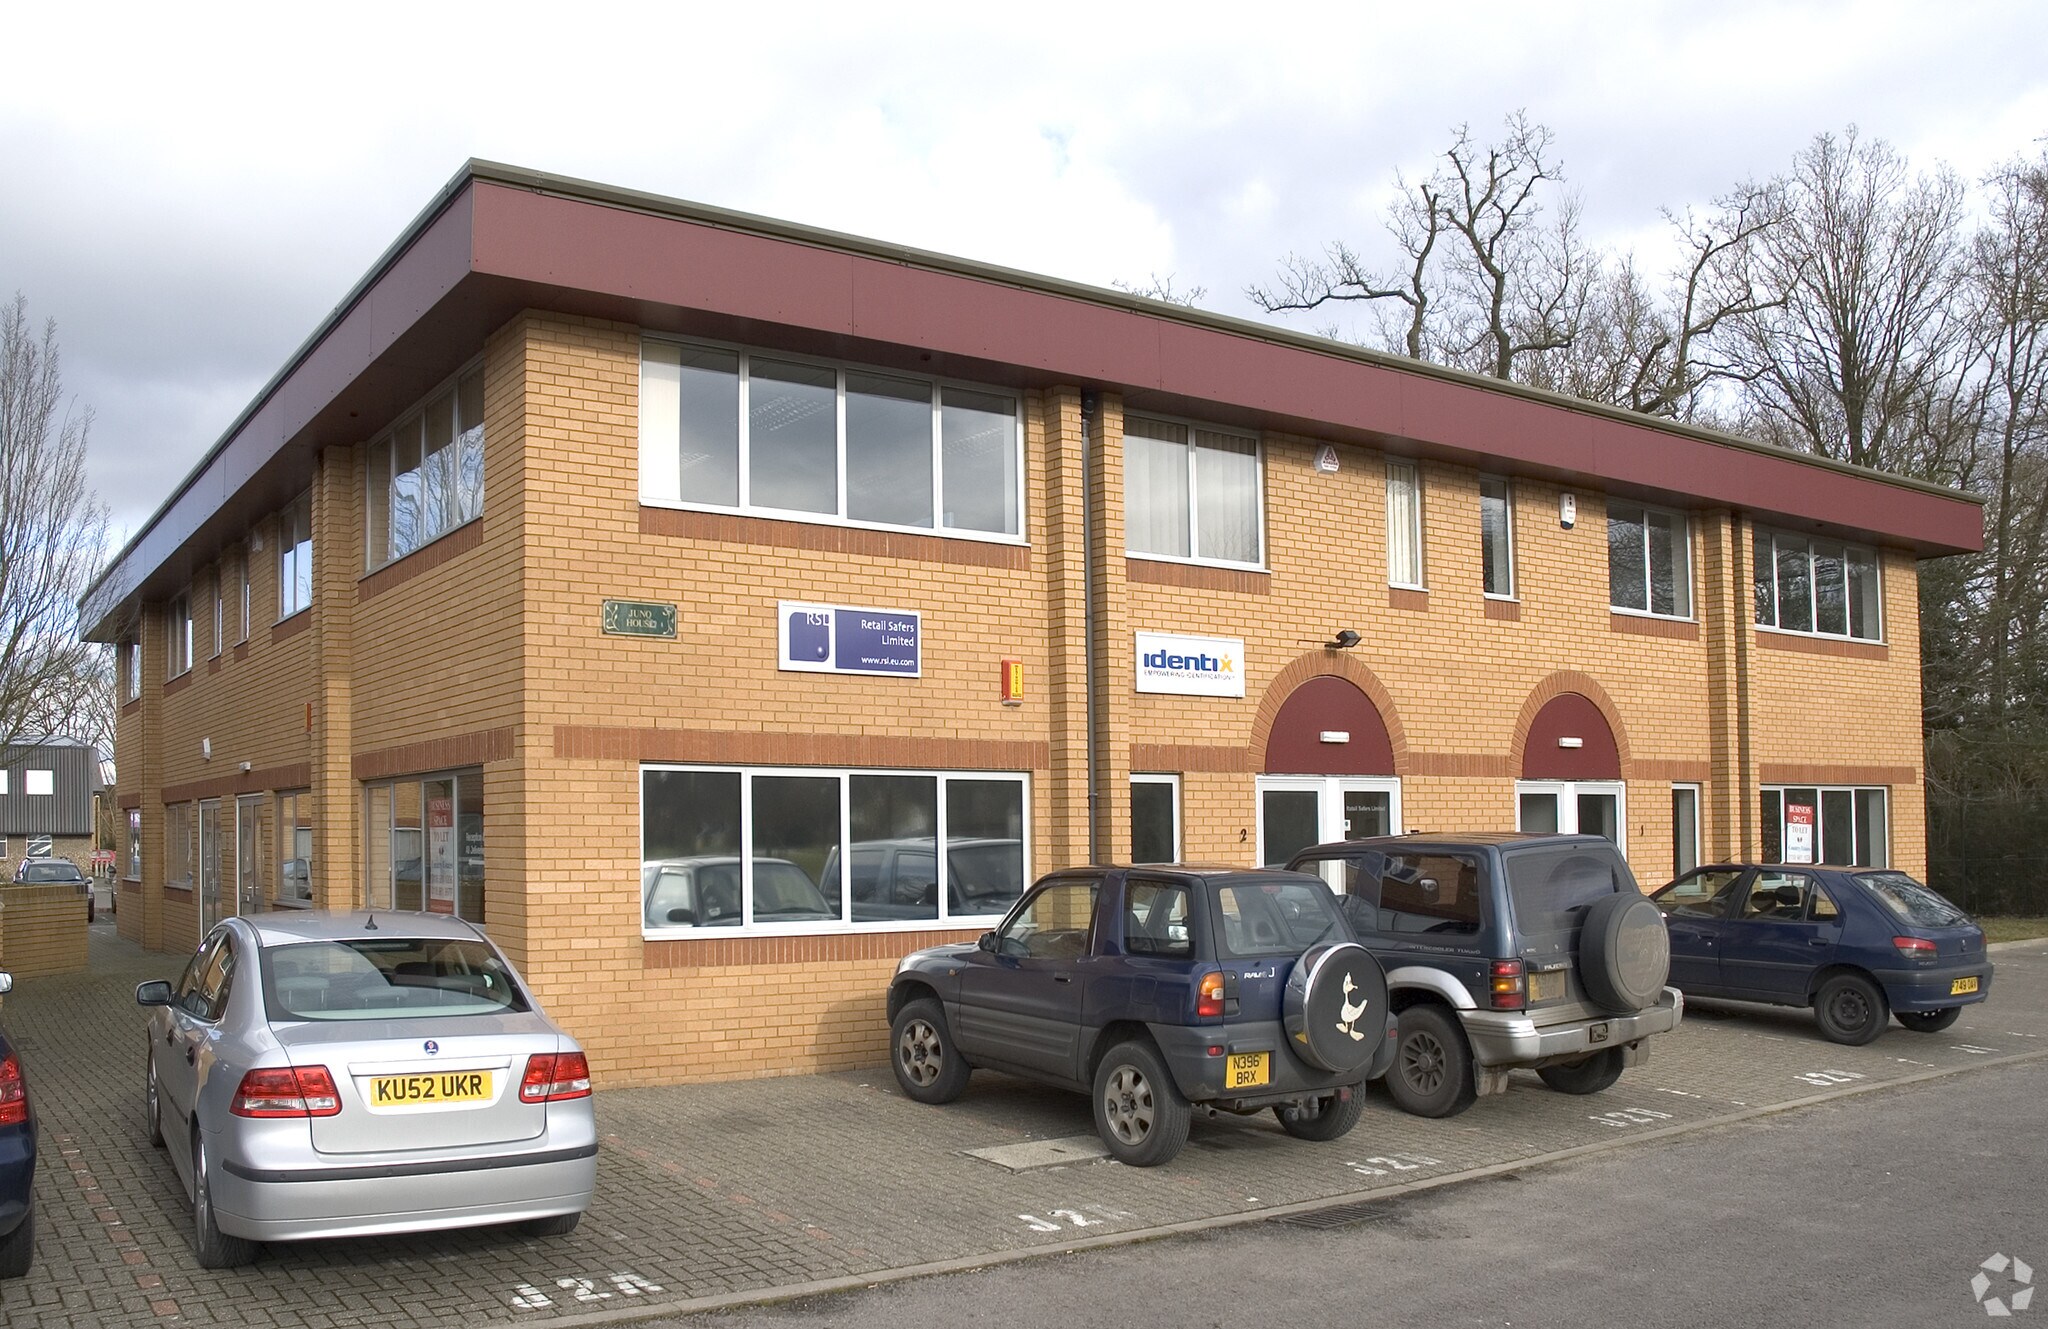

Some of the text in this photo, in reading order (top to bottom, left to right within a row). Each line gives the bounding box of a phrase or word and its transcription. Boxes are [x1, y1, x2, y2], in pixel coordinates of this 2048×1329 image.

[628, 609, 652, 619] JUNO
[626, 618, 657, 628] HOUSE
[861, 619, 915, 633] Retail Safers
[881, 635, 915, 647] Limited
[861, 656, 915, 667] www.rsl.eu.com
[1144, 649, 1233, 672] identix
[1789, 805, 1811, 814] BUSINESS
[1239, 828, 1247, 843] 2
[1233, 1054, 1260, 1070] N396
[1236, 1070, 1257, 1085] BRX
[377, 1074, 482, 1102] KU52 UKR
